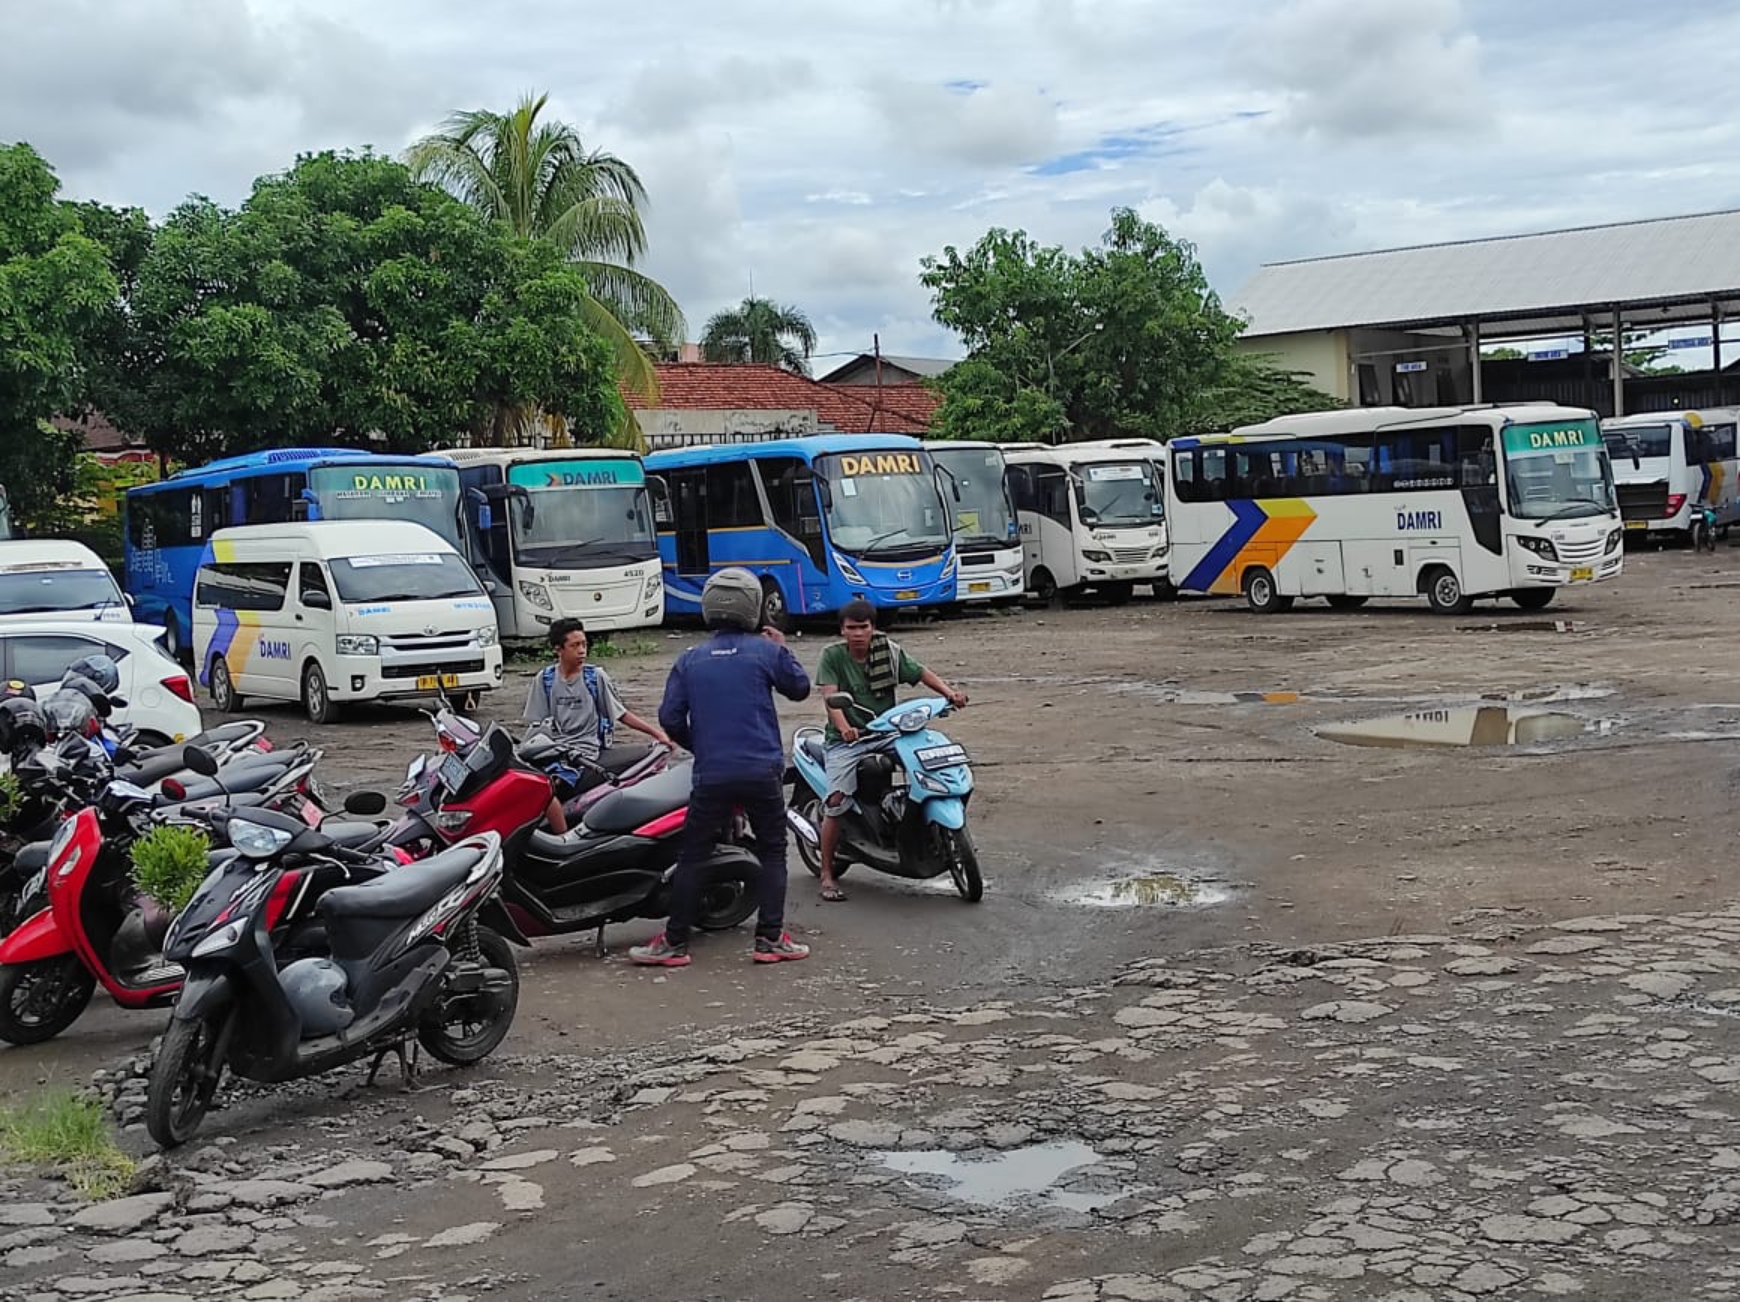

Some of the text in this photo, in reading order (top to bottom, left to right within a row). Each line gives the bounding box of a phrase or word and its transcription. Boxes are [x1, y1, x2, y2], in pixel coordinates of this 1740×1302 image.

[1530, 430, 1584, 448] DAMRI
[841, 454, 920, 476] DAMRI
[354, 475, 426, 490] DAMRI
[563, 470, 617, 486] DAMRI
[1397, 511, 1442, 530] DAMRI
[260, 640, 291, 660] DAMRI
